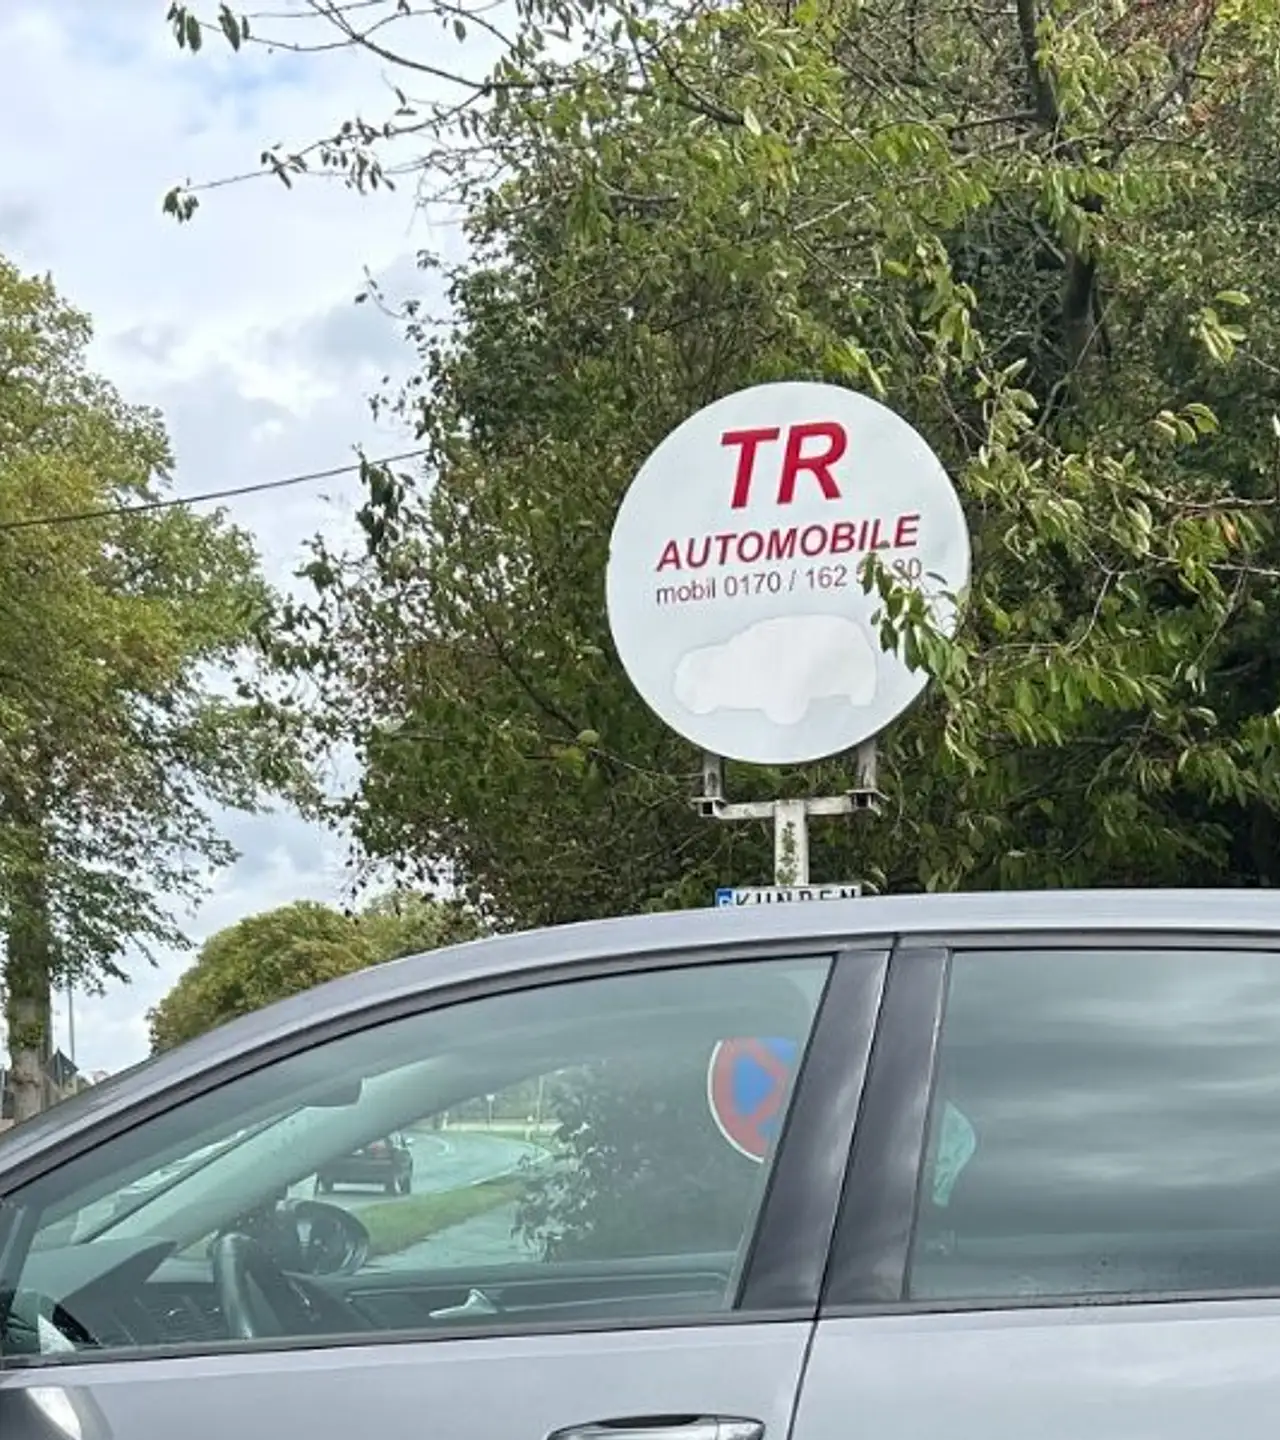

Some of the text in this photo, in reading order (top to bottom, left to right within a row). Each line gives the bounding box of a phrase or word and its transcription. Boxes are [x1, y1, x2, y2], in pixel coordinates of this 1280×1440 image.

[721, 422, 847, 509] TR
[656, 515, 920, 572] AUTOMOBILE
[656, 579, 716, 605] mobil
[724, 570, 781, 597] 0170
[789, 568, 798, 592] /
[806, 563, 848, 590] 162
